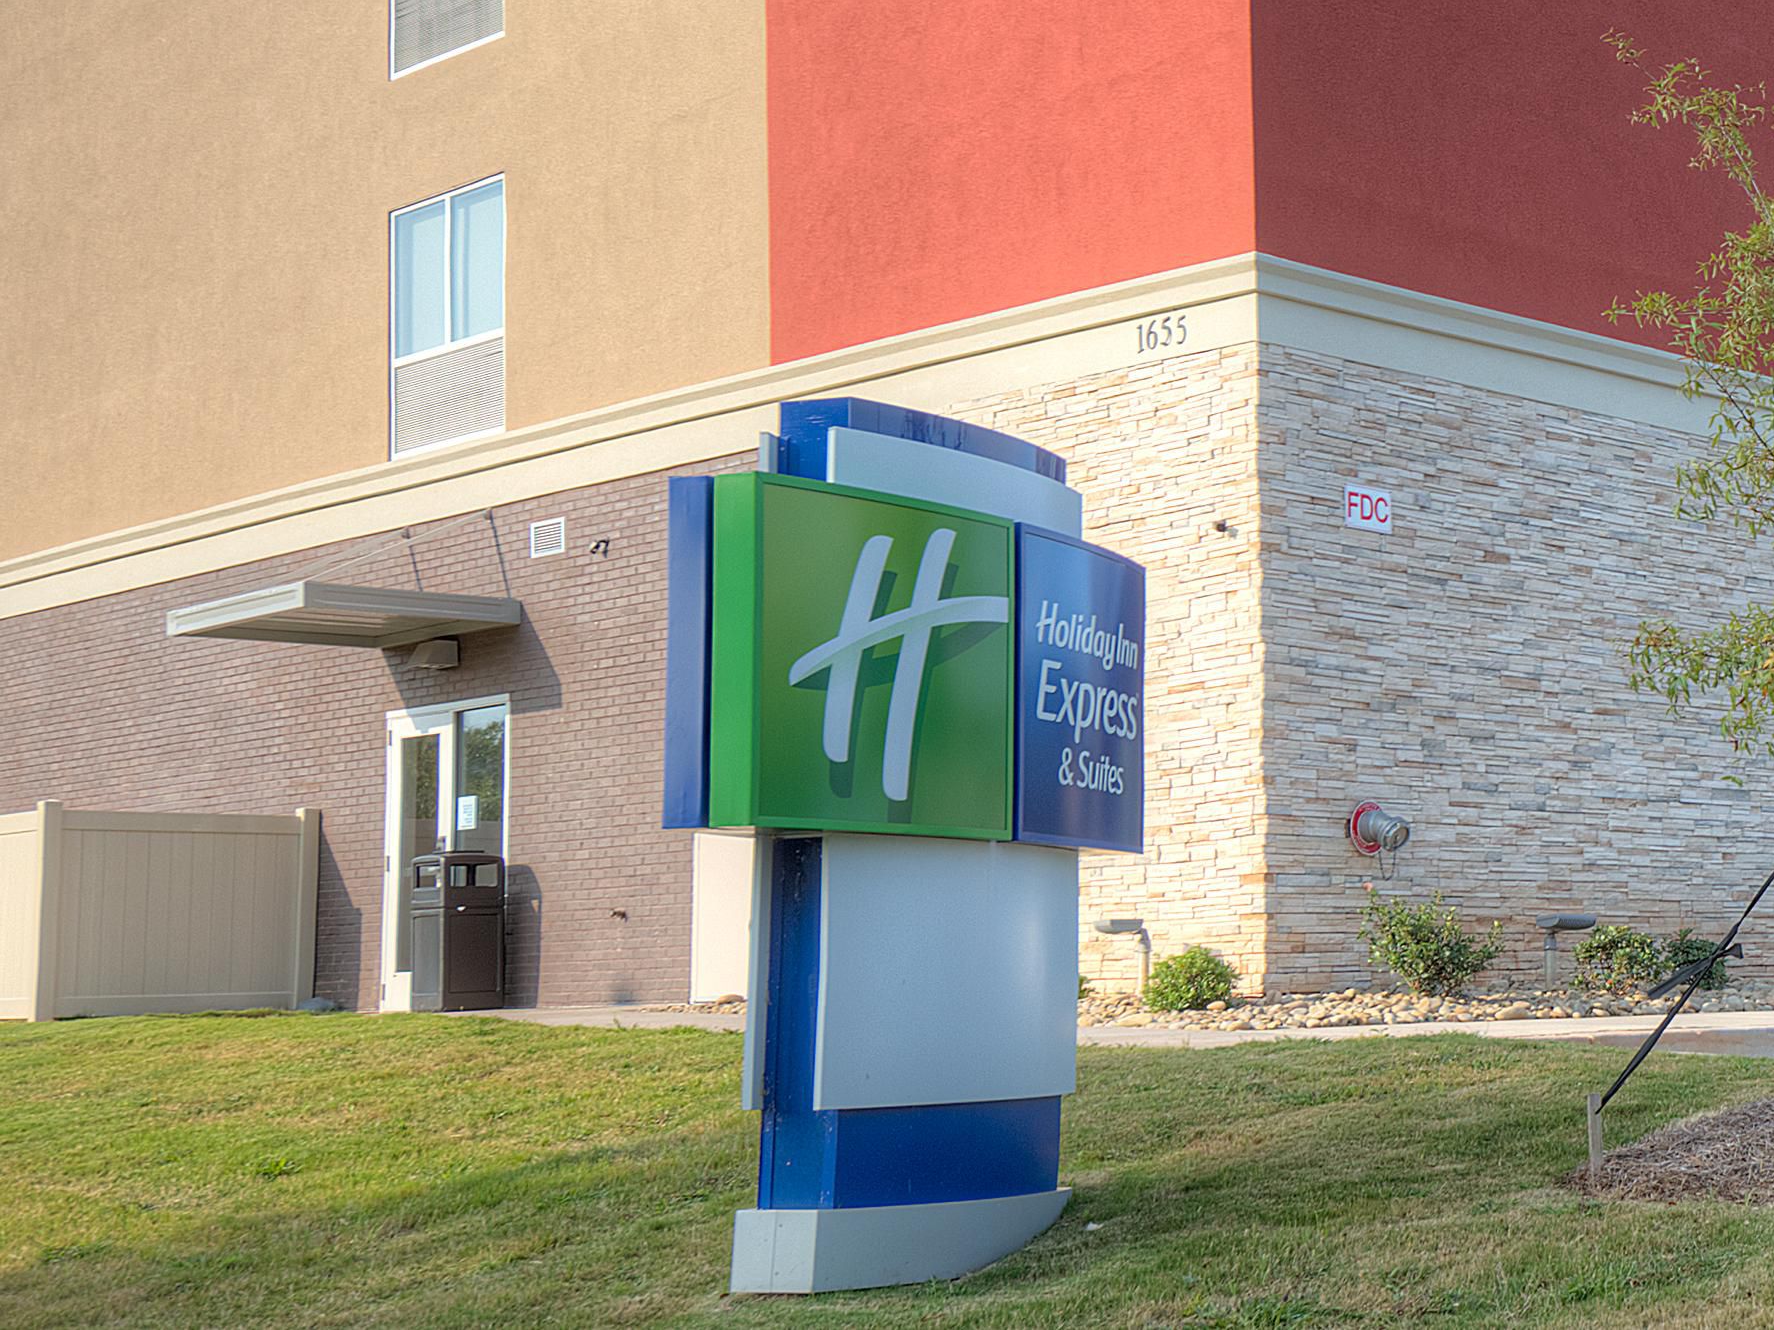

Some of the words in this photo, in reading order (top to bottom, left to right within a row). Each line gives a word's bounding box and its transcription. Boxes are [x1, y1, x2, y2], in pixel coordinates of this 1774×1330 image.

[1136, 315, 1187, 354] 1655
[1347, 491, 1389, 524] FDC
[789, 527, 1008, 801] H
[1035, 600, 1117, 671] Holiday
[1116, 623, 1139, 670] Inn
[1036, 658, 1138, 745] Express
[1058, 747, 1075, 787] &
[1076, 750, 1125, 796] Suites
